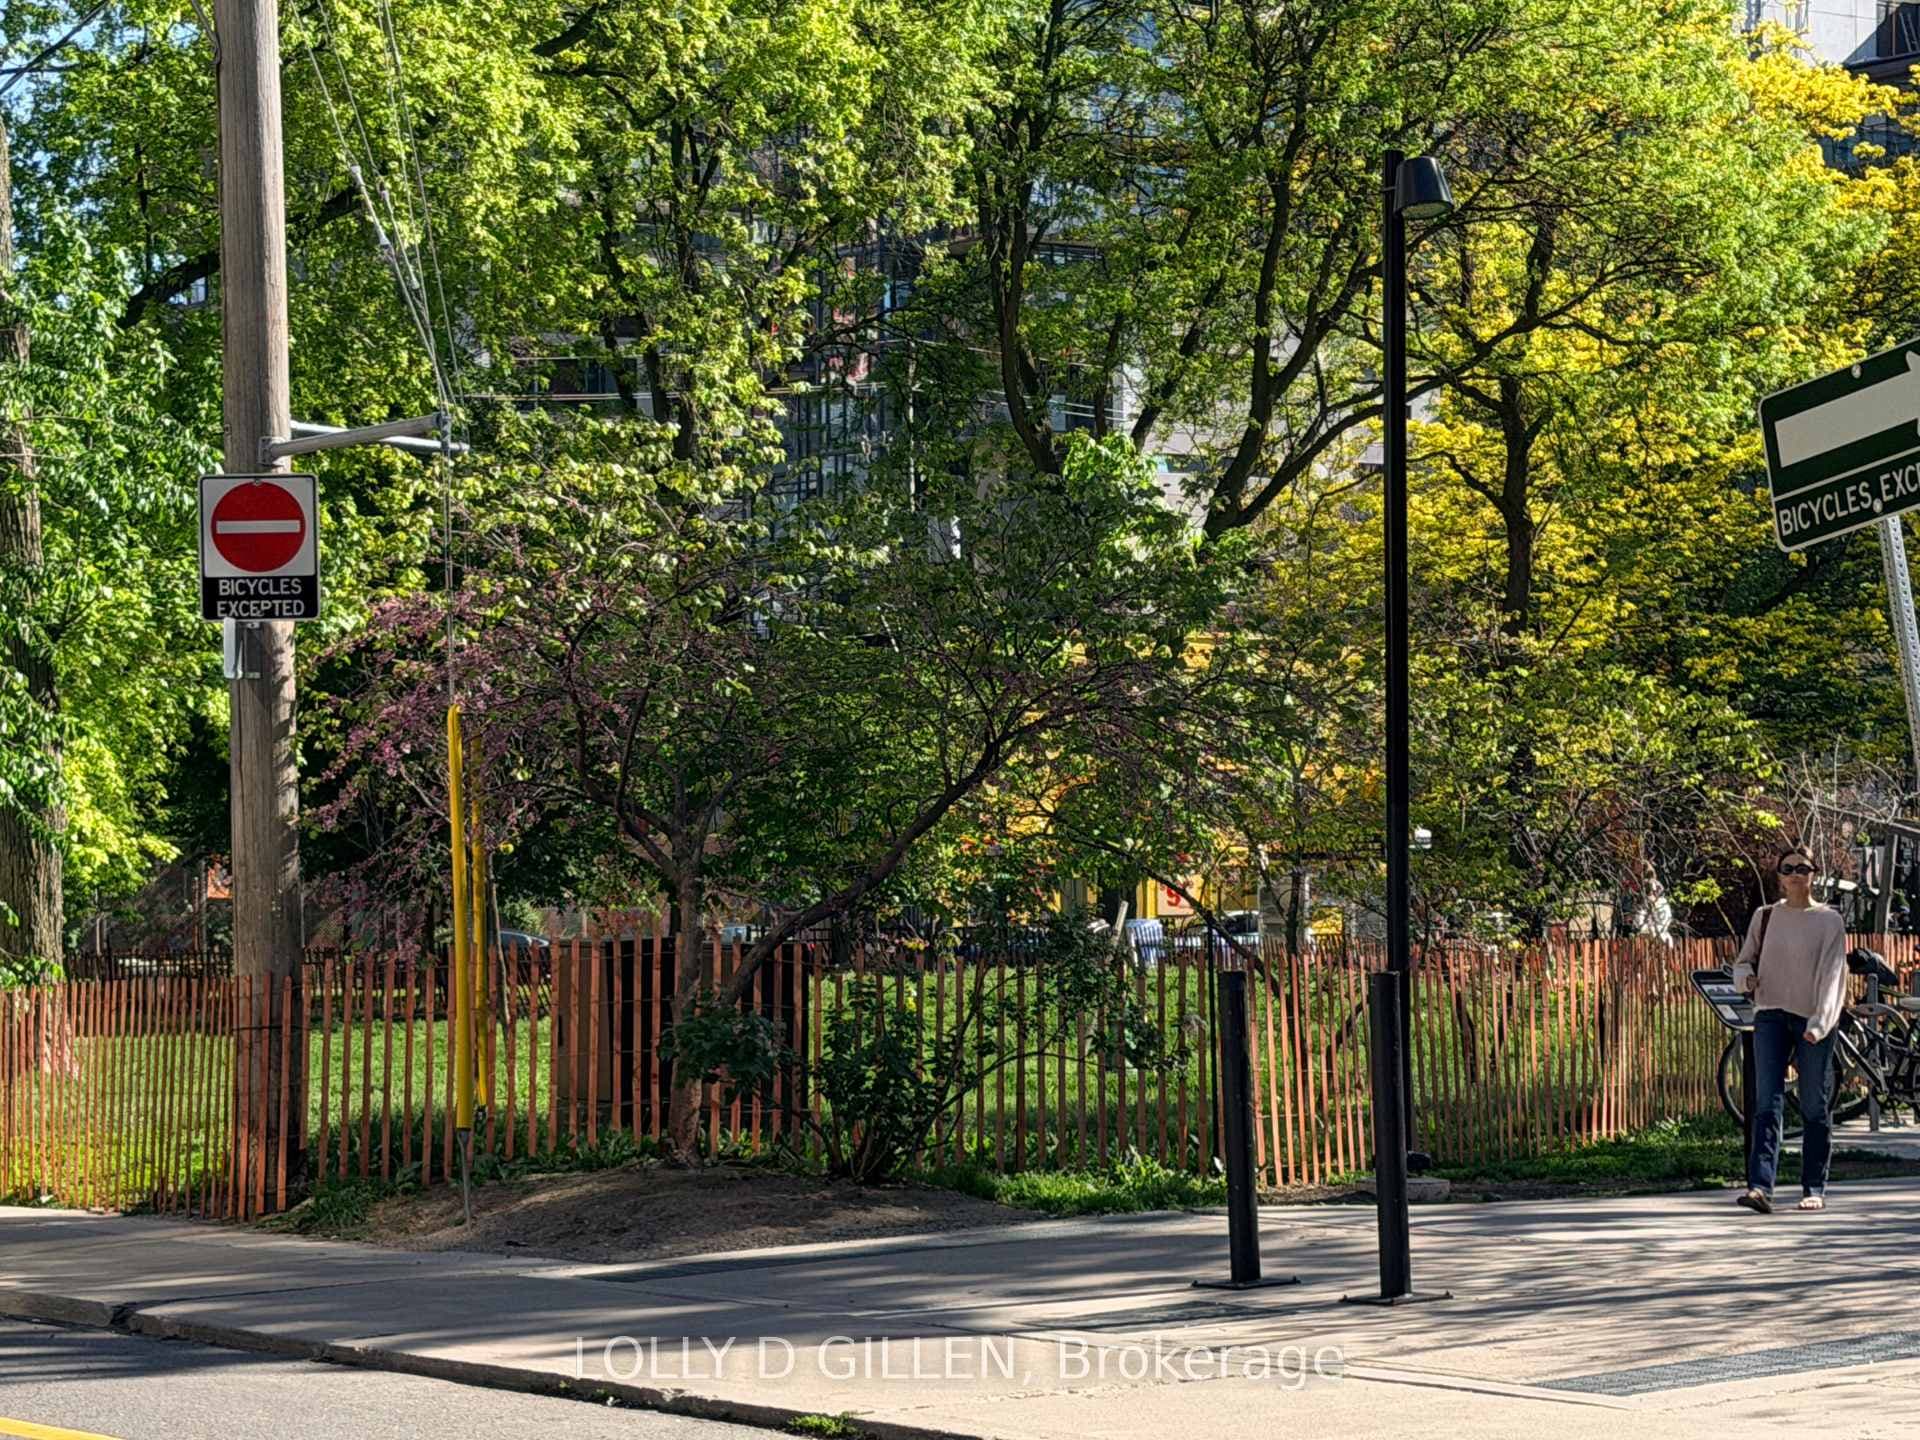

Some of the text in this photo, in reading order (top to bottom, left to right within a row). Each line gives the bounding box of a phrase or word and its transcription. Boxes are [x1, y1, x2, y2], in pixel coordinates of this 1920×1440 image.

[1779, 481, 1872, 537] BICYCLES
[218, 578, 302, 596] BICYCLES
[216, 599, 305, 617] EXCEPTED
